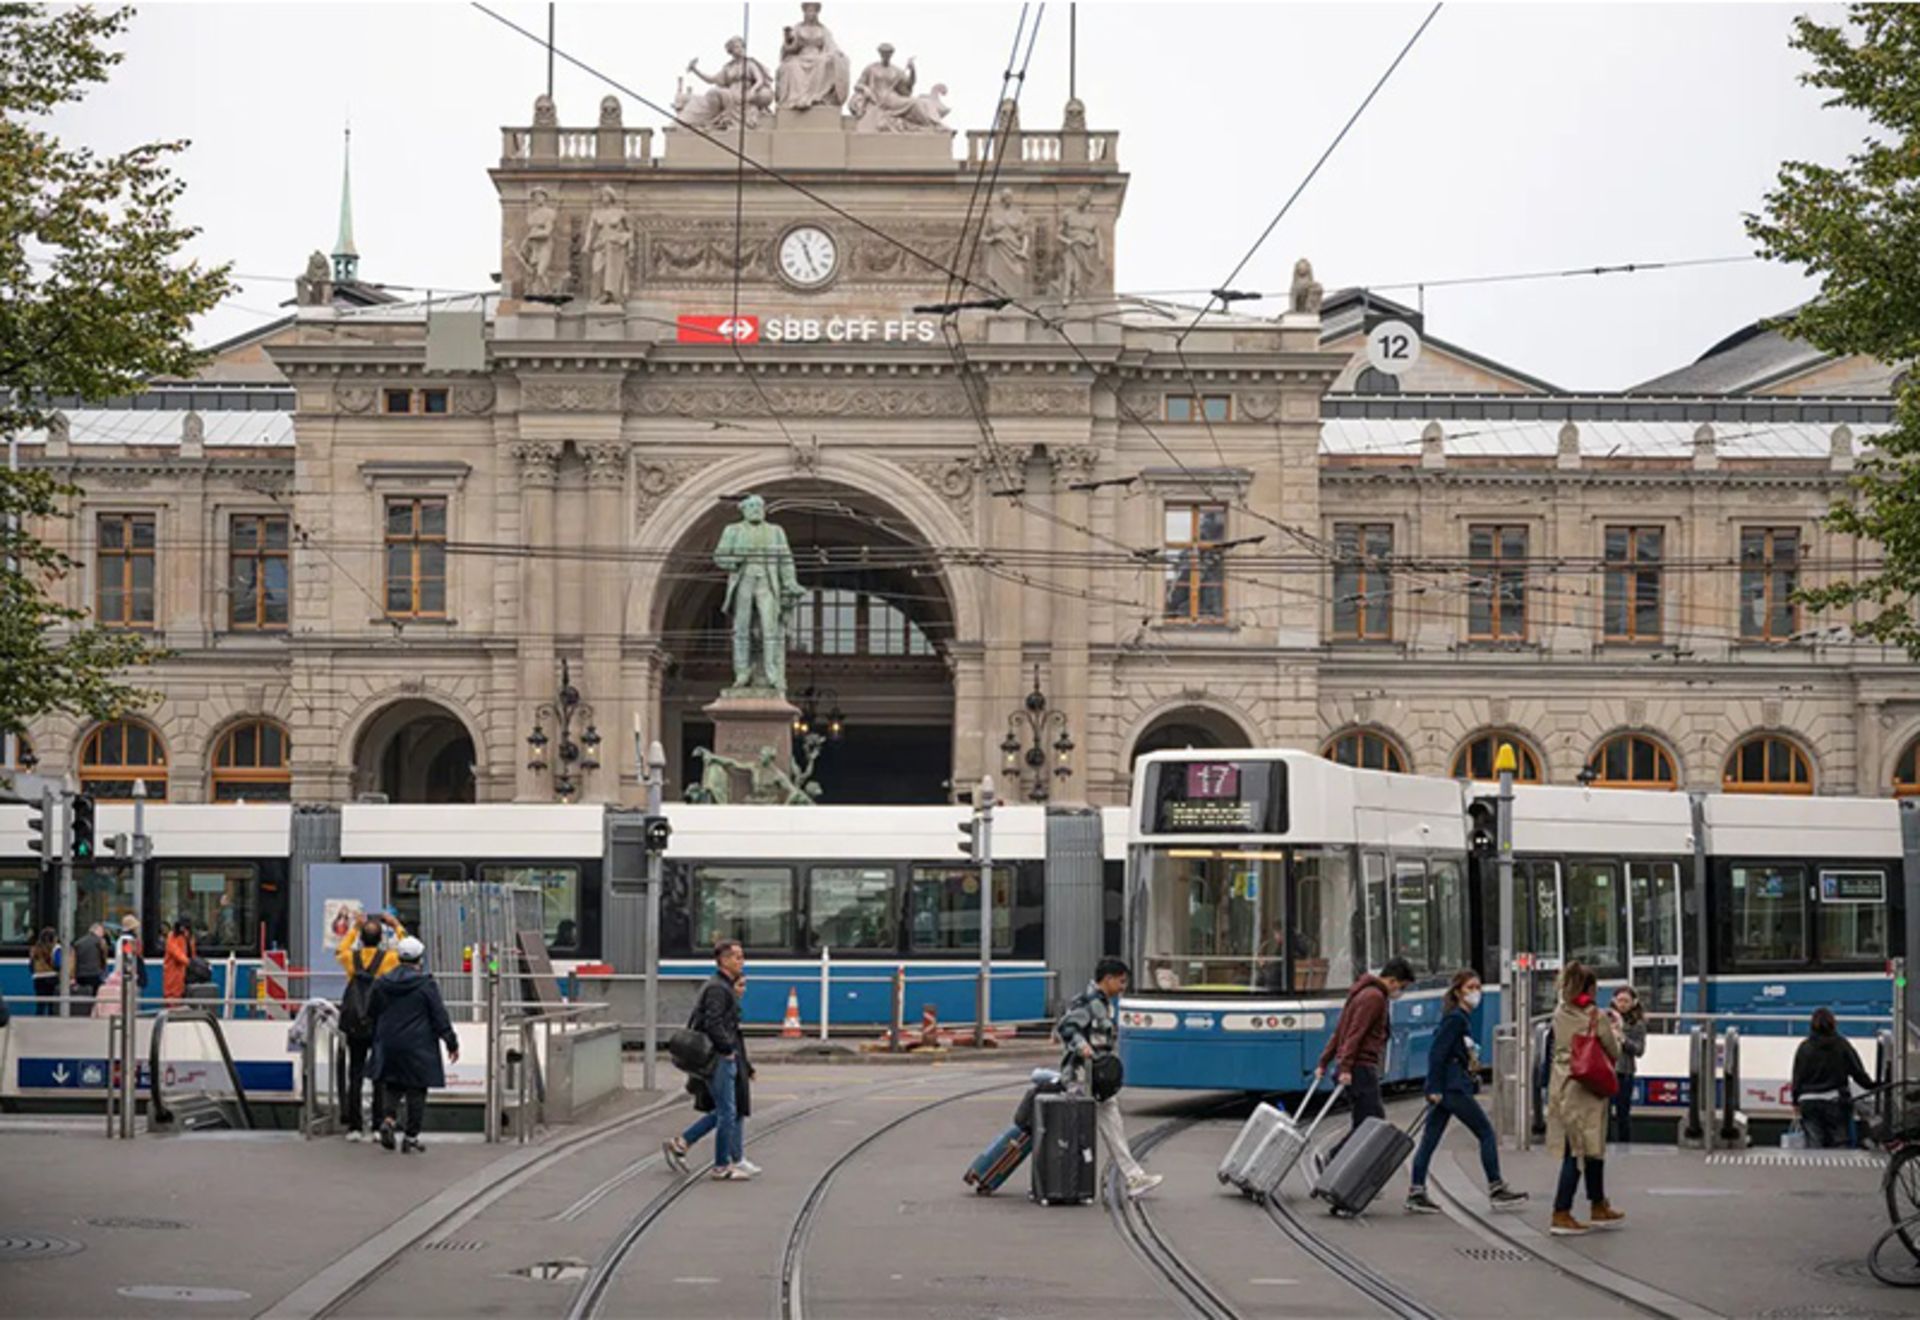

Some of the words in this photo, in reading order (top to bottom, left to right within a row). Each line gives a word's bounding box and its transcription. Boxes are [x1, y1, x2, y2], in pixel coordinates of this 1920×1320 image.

[766, 319, 820, 341] SBB
[826, 319, 878, 341] CFF
[885, 320, 934, 342] FFS
[1378, 335, 1409, 359] 12
[1197, 764, 1231, 794] 17
